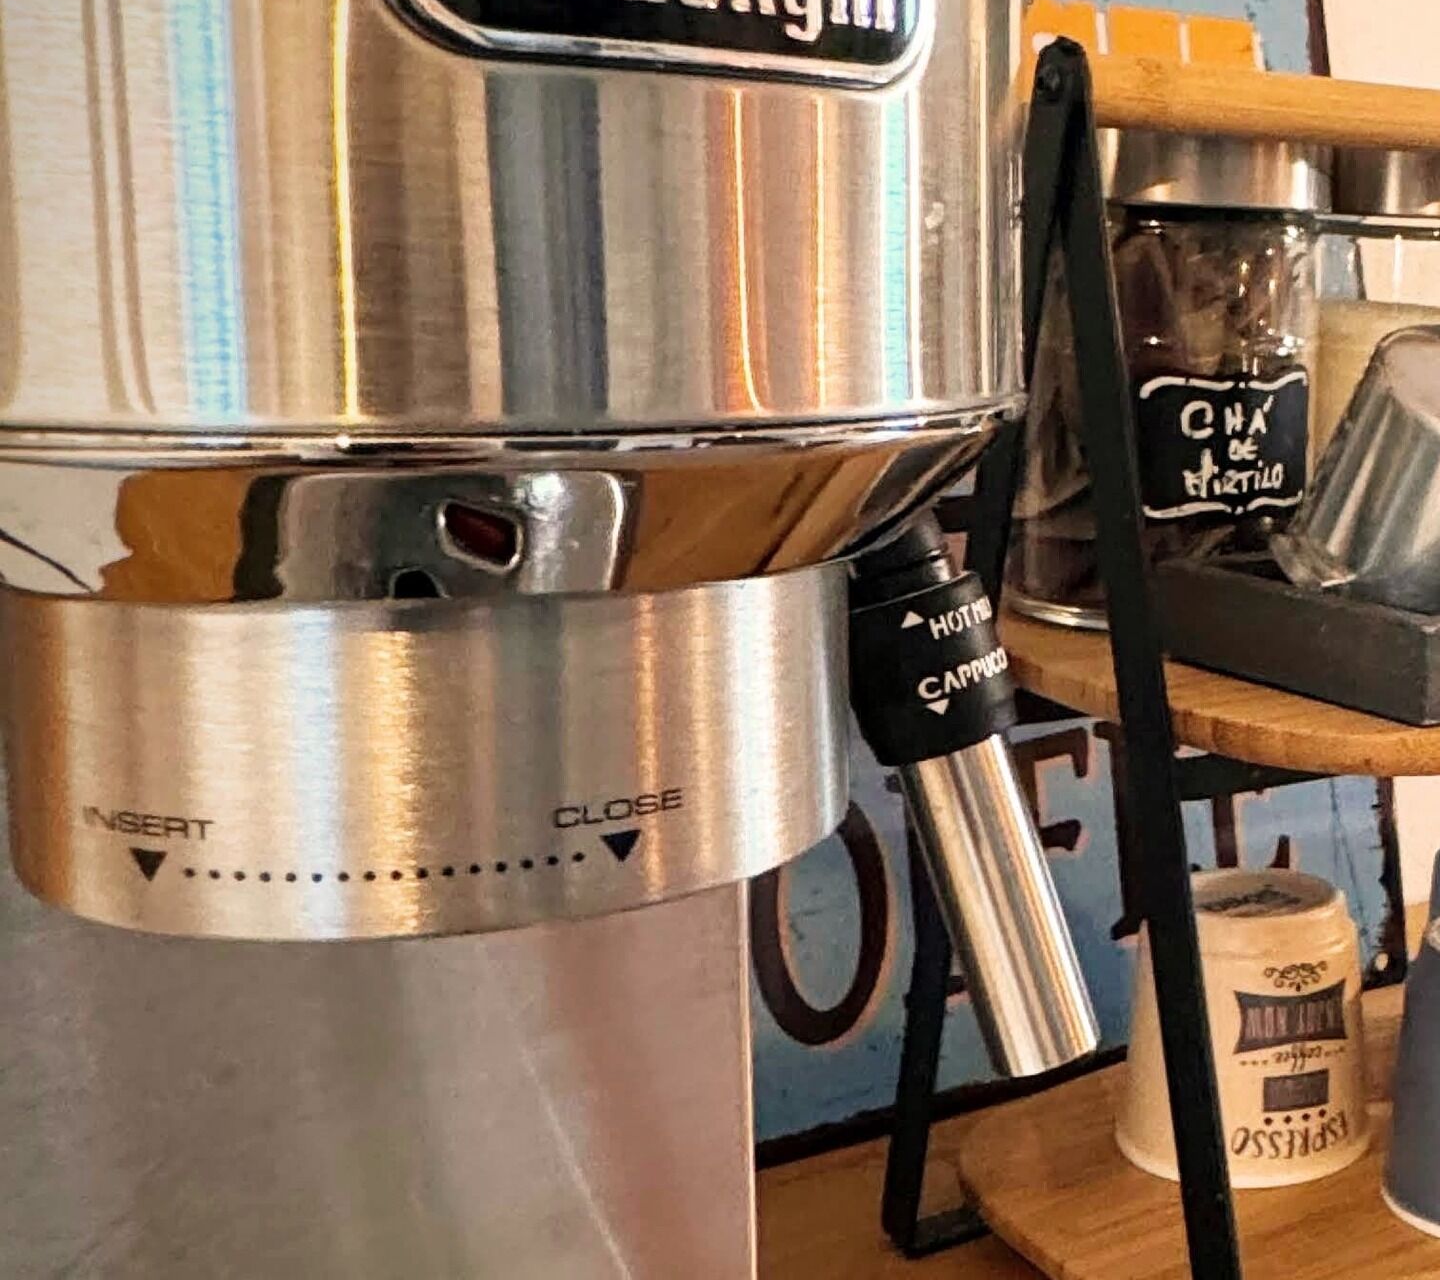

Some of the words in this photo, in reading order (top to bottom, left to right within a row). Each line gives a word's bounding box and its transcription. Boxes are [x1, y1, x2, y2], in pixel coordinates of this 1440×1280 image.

[1180, 395, 1275, 439] CHÁ
[929, 604, 972, 640] HOT
[83, 805, 214, 841] INSERT
[552, 788, 685, 830] CLOSE
[1230, 1110, 1349, 1160] ESPRESSO
